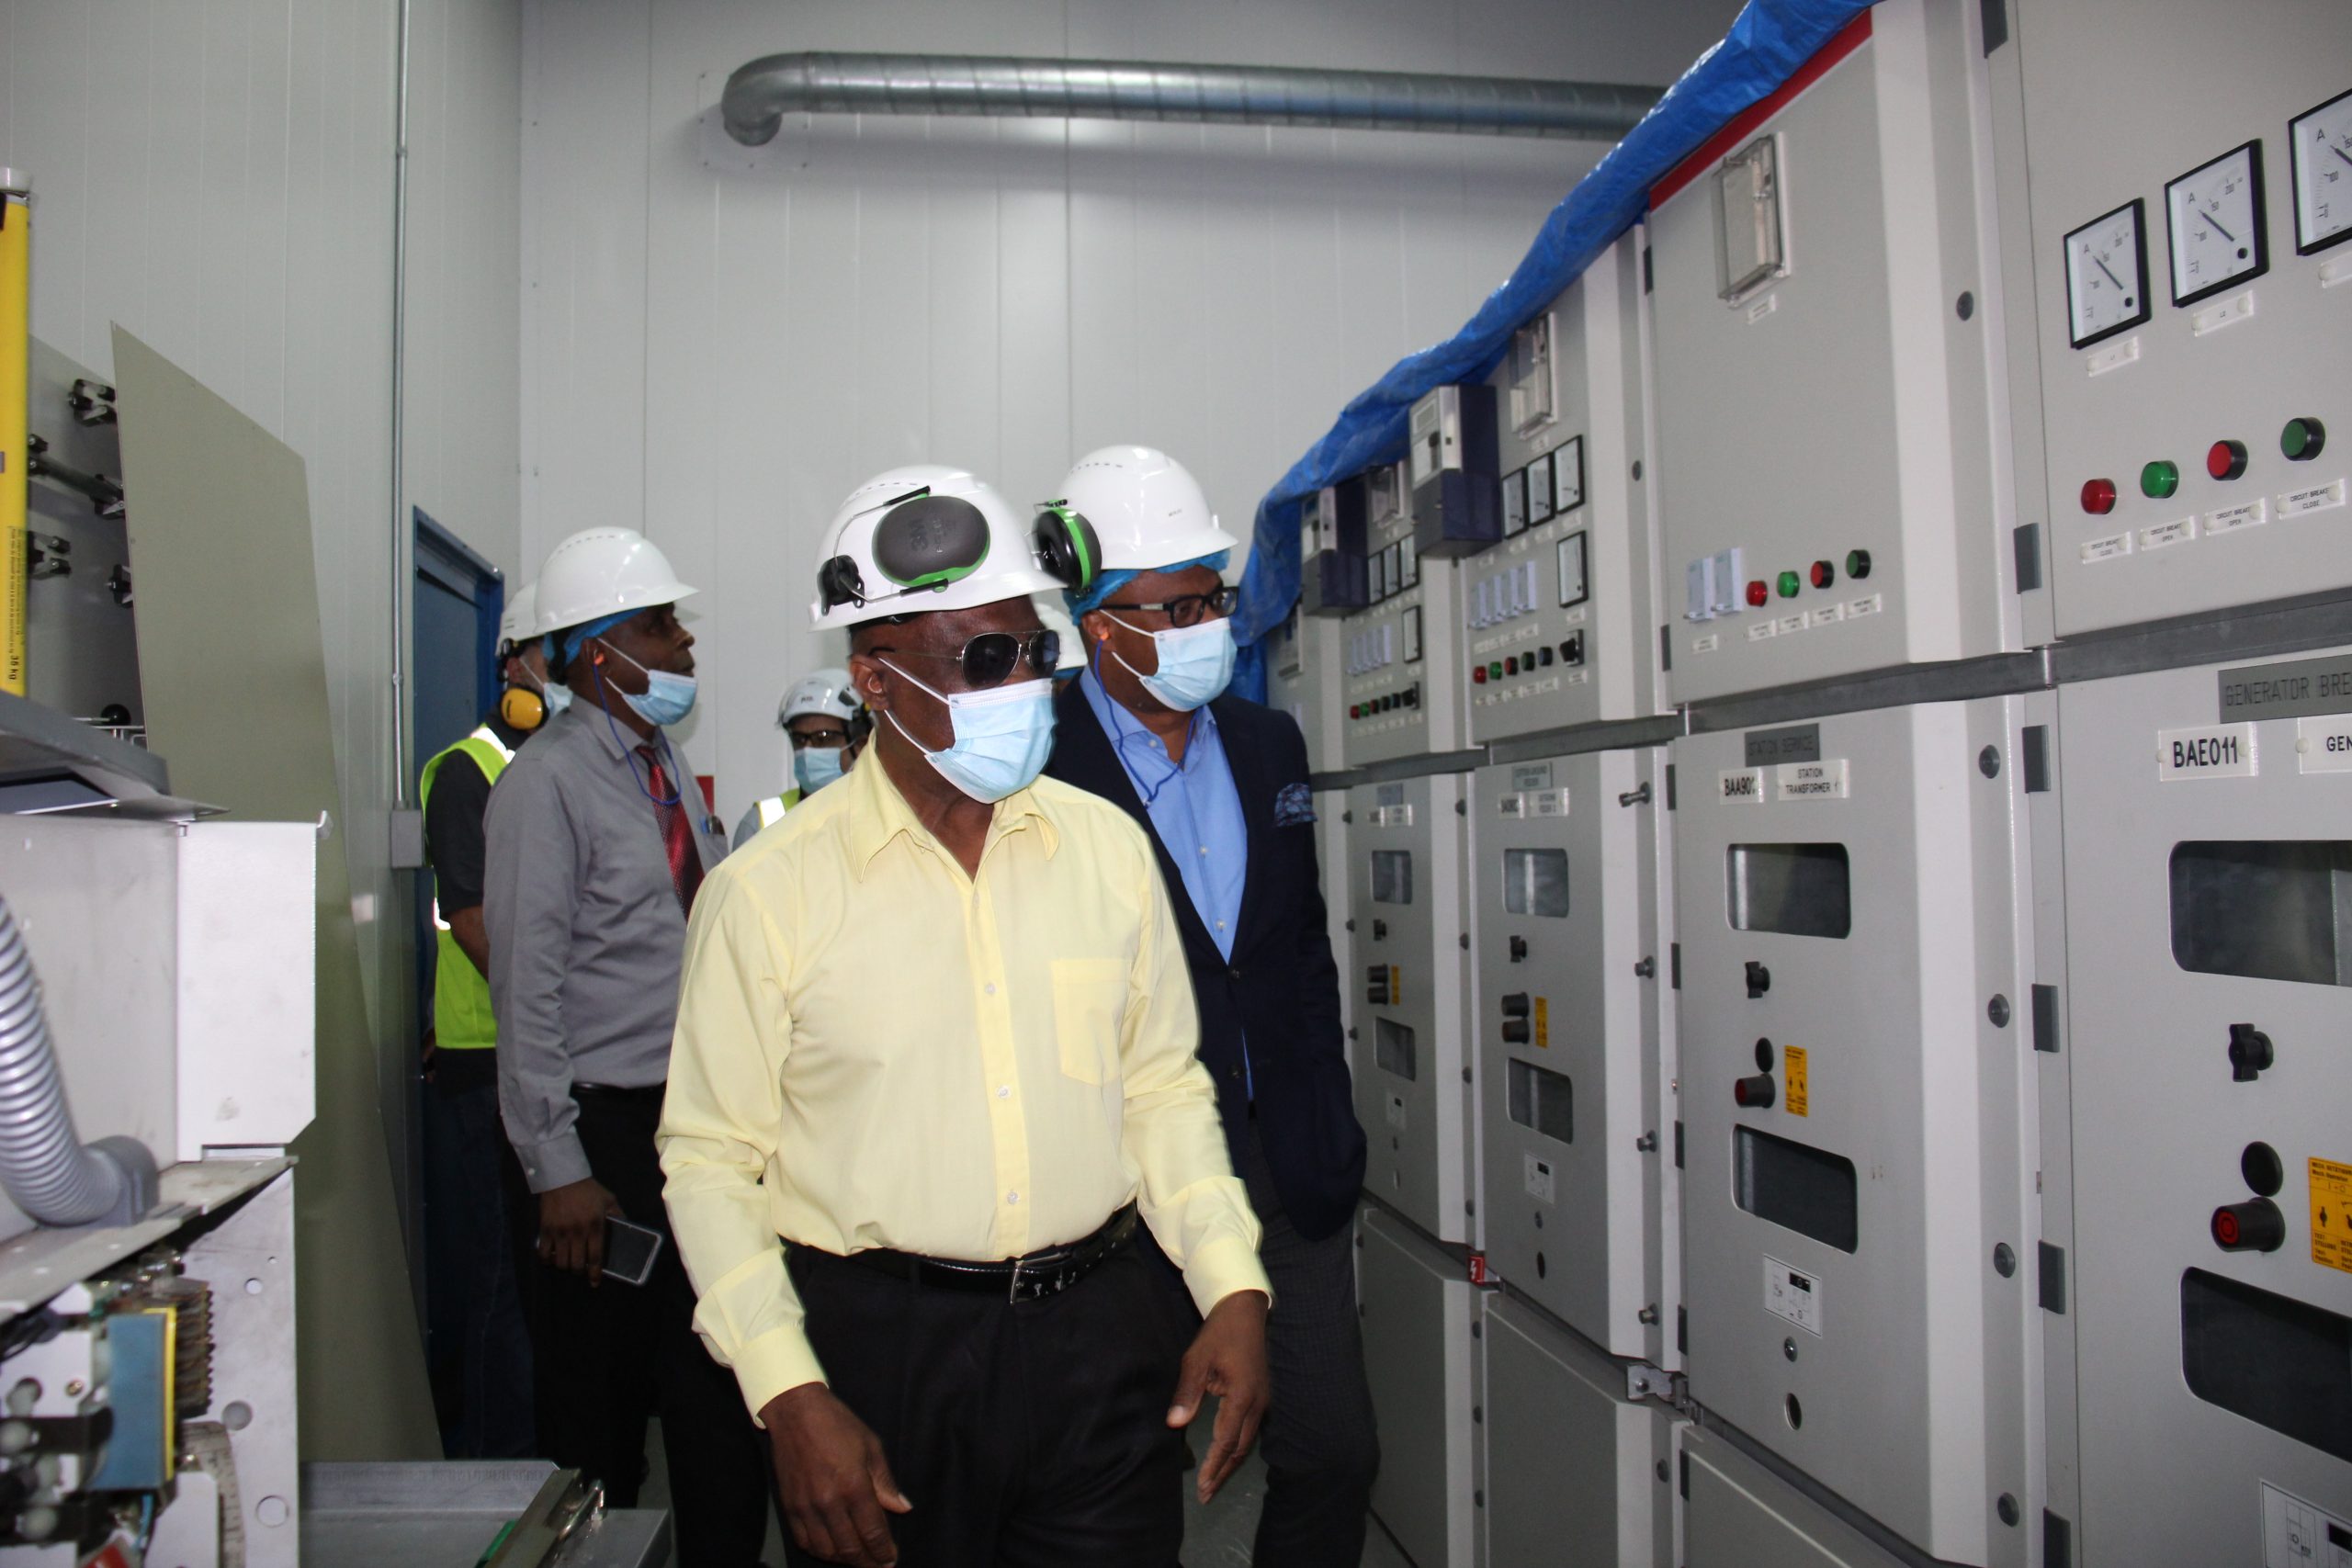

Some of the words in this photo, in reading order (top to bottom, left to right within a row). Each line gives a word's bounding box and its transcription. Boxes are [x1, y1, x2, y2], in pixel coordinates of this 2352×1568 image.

[2290, 491, 2308, 502] CIRCUIT
[2310, 487, 2331, 498] BREAKE
[2302, 499, 2320, 510] CLOSE
[2216, 510, 2233, 520] CIRCUIT
[2228, 518, 2242, 526] OPEN
[2226, 676, 2310, 706] GENERATOR
[2173, 736, 2238, 768] BAE011
[1798, 768, 1824, 779] STATION
[1786, 782, 1831, 795] TRANSFORMER
